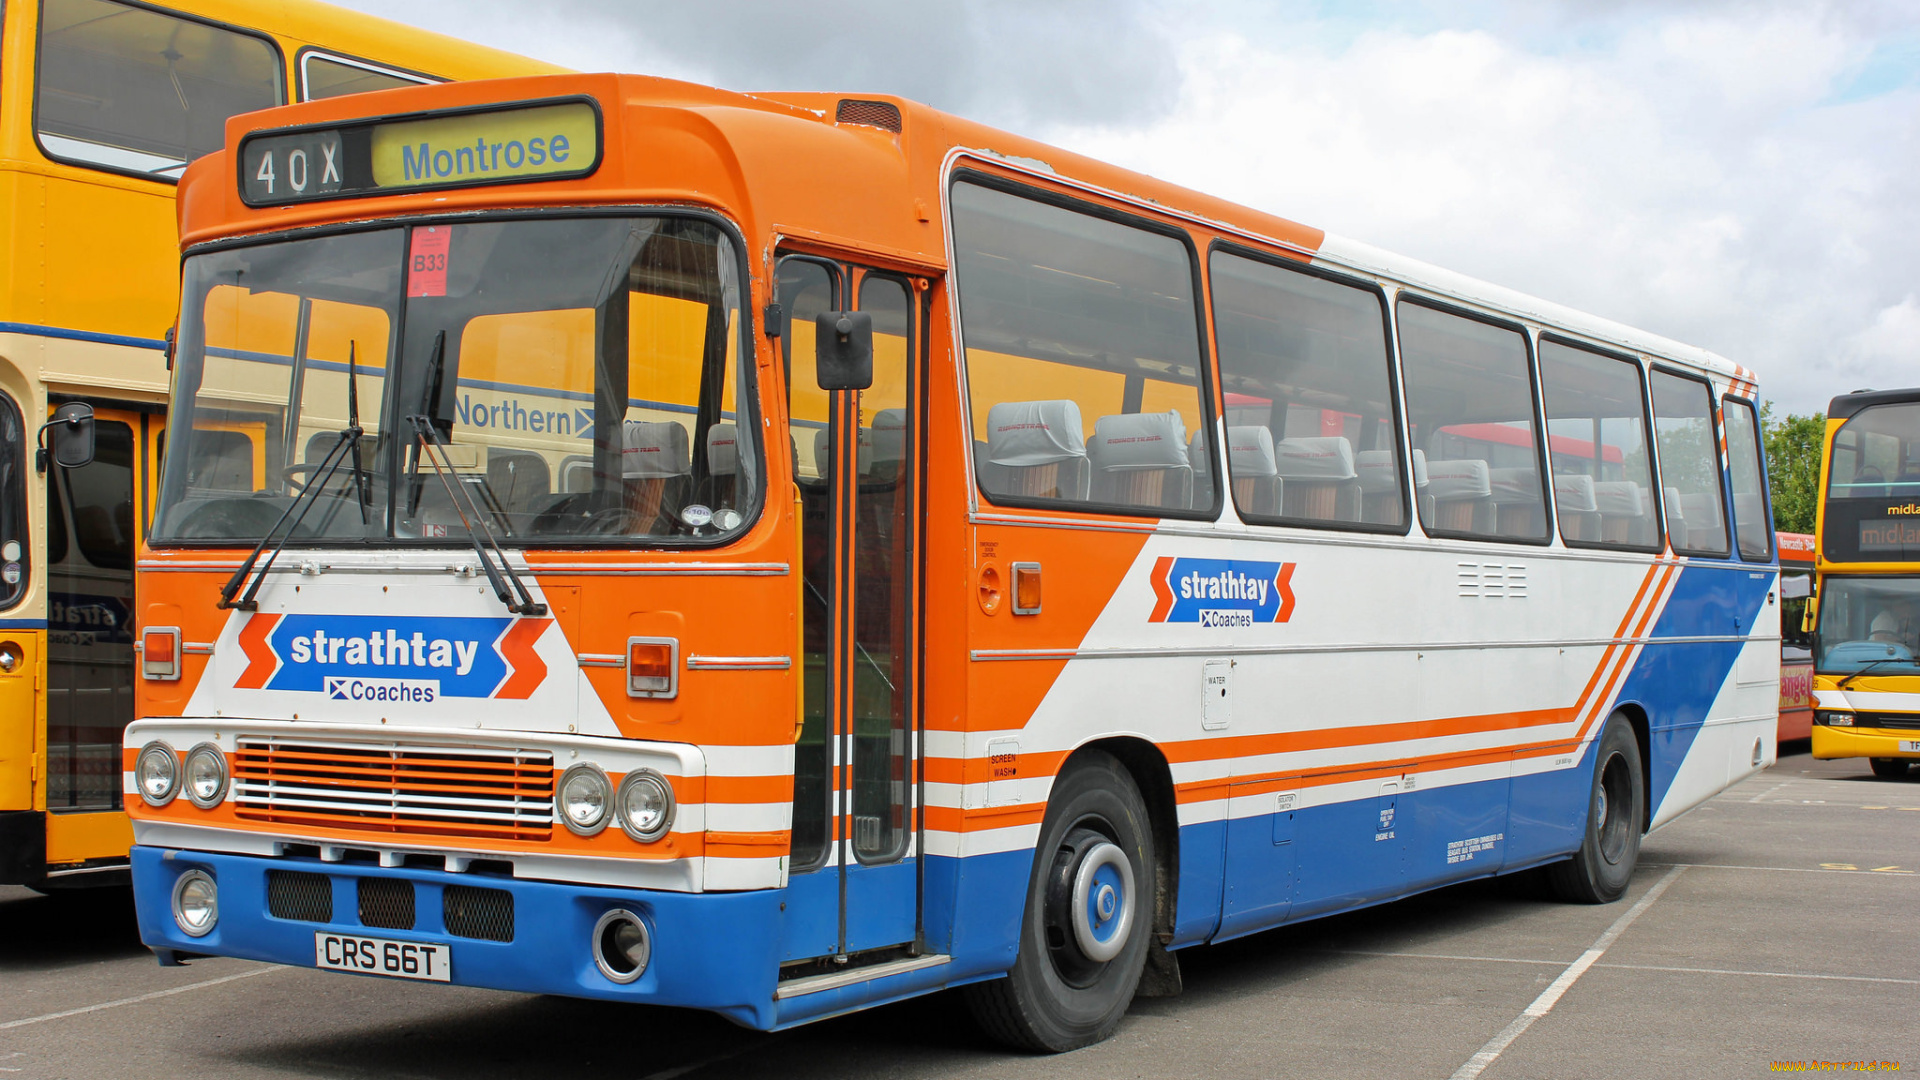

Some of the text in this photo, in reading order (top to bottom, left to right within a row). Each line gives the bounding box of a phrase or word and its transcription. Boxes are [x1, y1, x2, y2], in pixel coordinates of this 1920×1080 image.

[403, 135, 570, 181] Montrose
[414, 254, 445, 272] B33
[454, 393, 571, 435] Northern
[1180, 570, 1269, 606] strathtay
[1212, 611, 1251, 627] Coaches
[291, 629, 478, 676] strathtay
[1208, 676, 1226, 684] WATER
[350, 681, 434, 702] Coaches
[991, 753, 1016, 765] SCREEN
[994, 767, 1013, 777] WASH
[325, 936, 437, 976] CRS 66T
